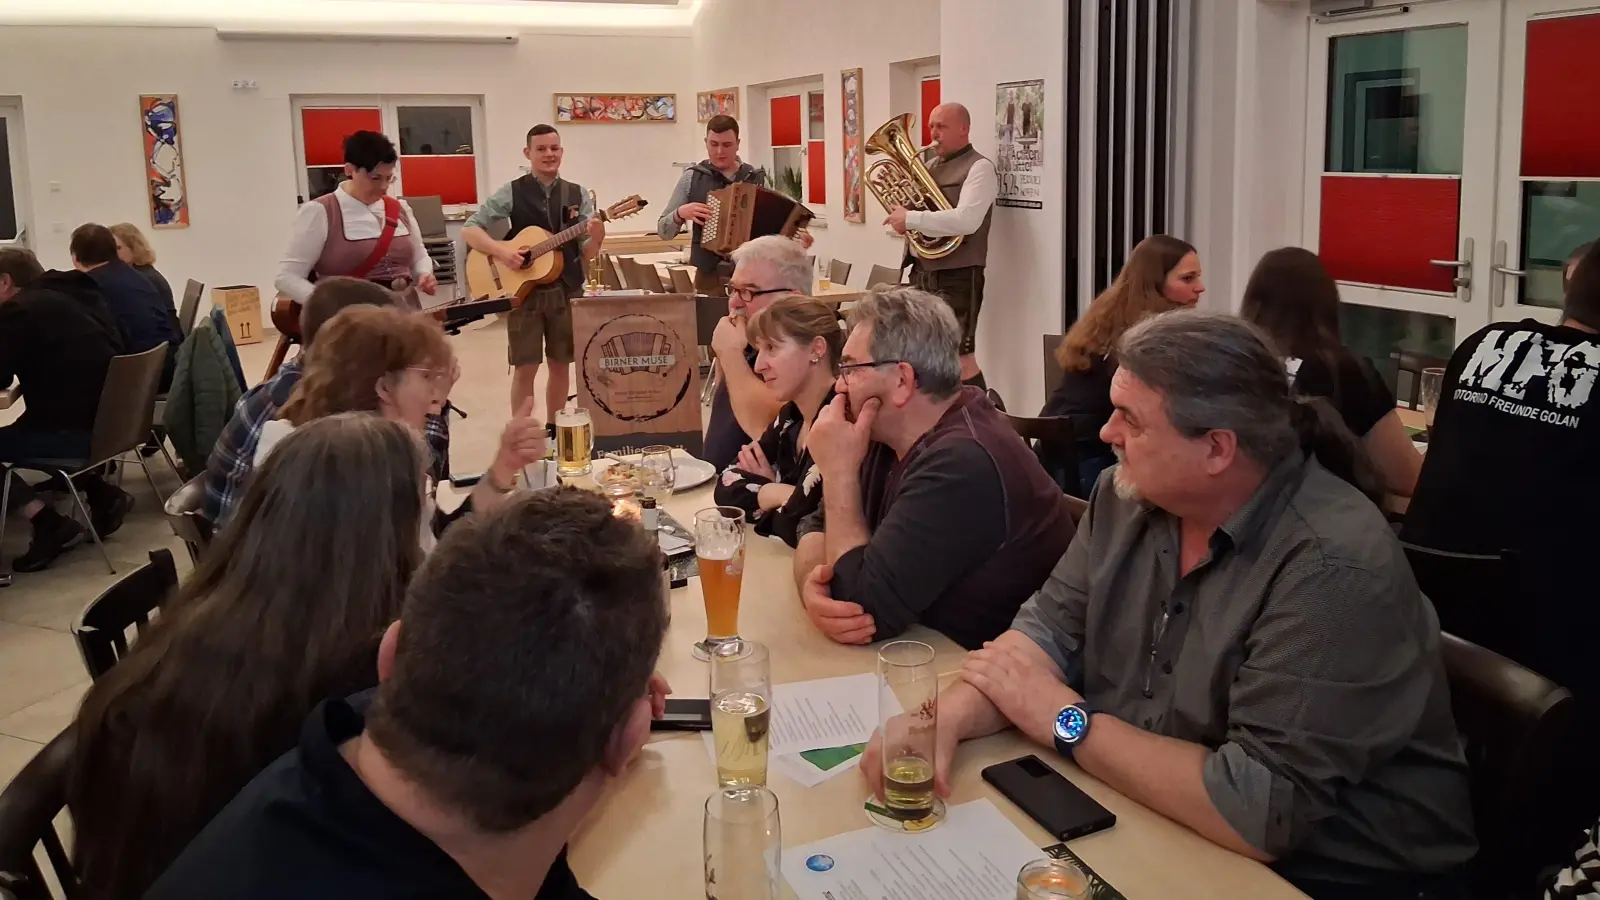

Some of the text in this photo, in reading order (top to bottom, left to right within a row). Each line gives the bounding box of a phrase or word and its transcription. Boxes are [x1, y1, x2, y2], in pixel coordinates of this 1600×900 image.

[604, 355, 668, 367] BIRNER MUSE
[1488, 396, 1540, 420] FREUNDE
[1540, 410, 1580, 429] GOLAN
